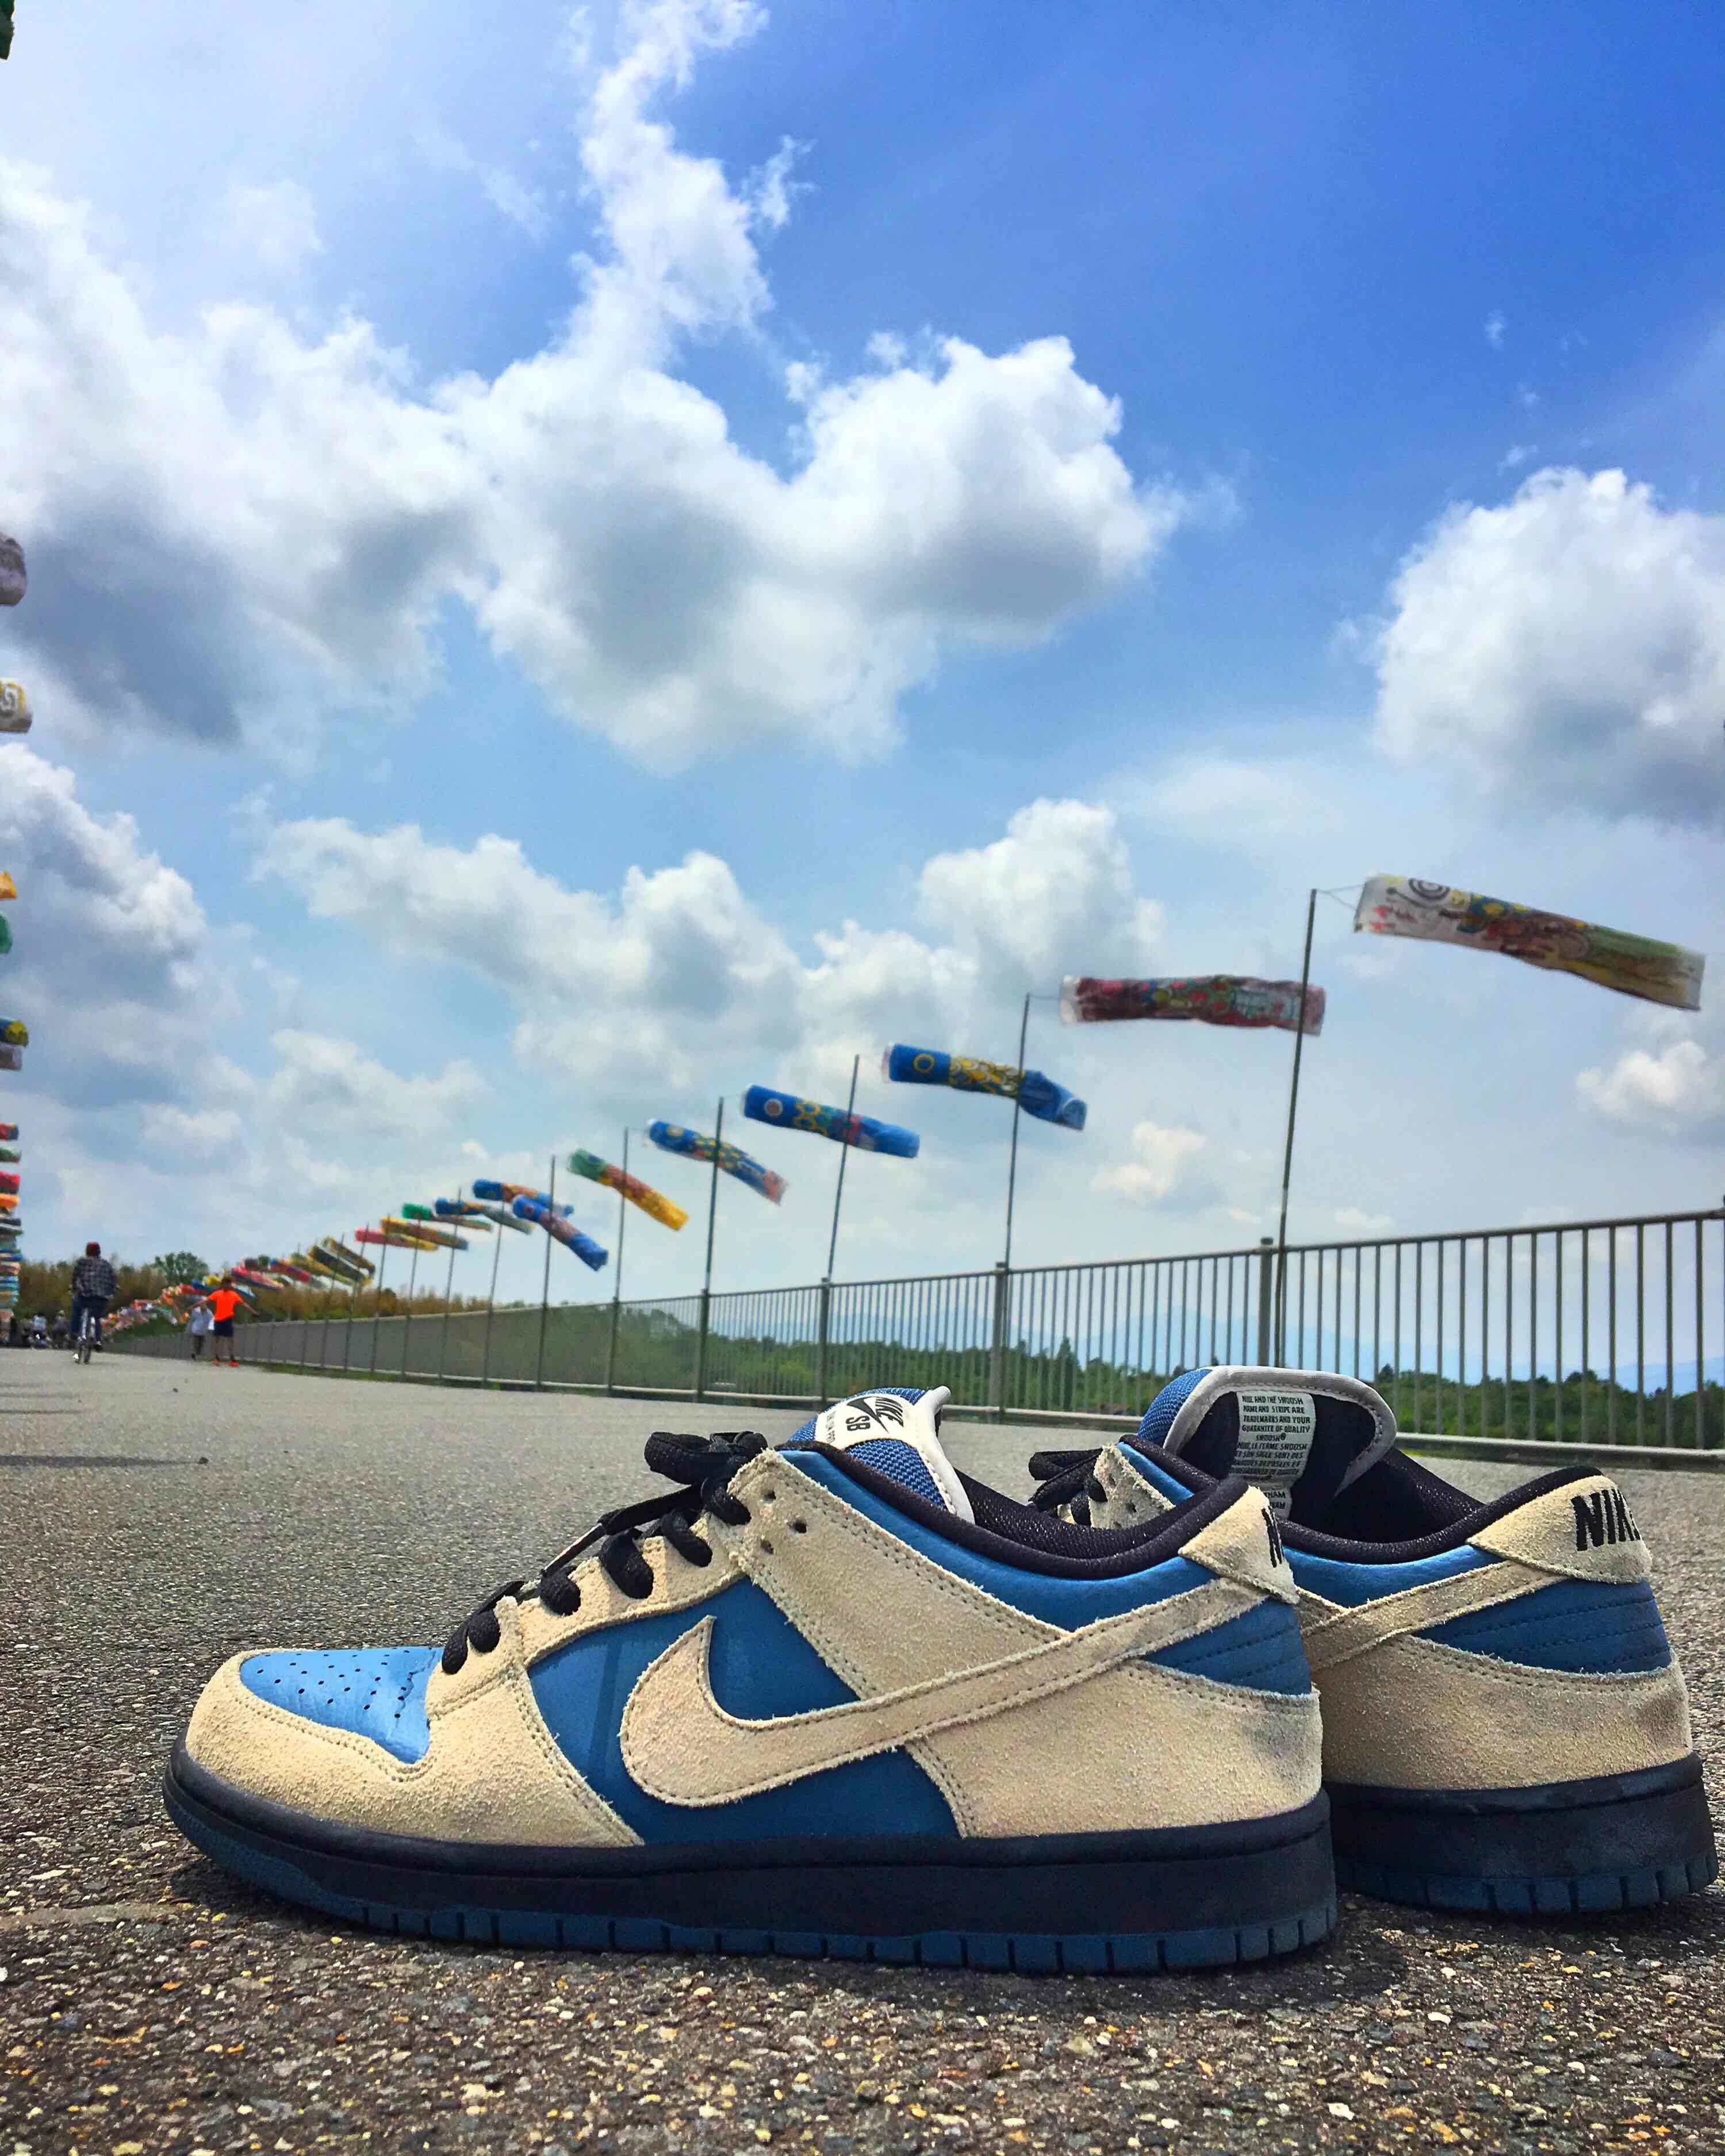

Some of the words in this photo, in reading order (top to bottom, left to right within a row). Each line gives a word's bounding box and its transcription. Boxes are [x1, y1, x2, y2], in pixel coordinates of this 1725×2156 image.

[1278, 1396, 1304, 1405] SWOOSH
[845, 1415, 871, 1432] SB
[1284, 1425, 1311, 1433] QUALITY
